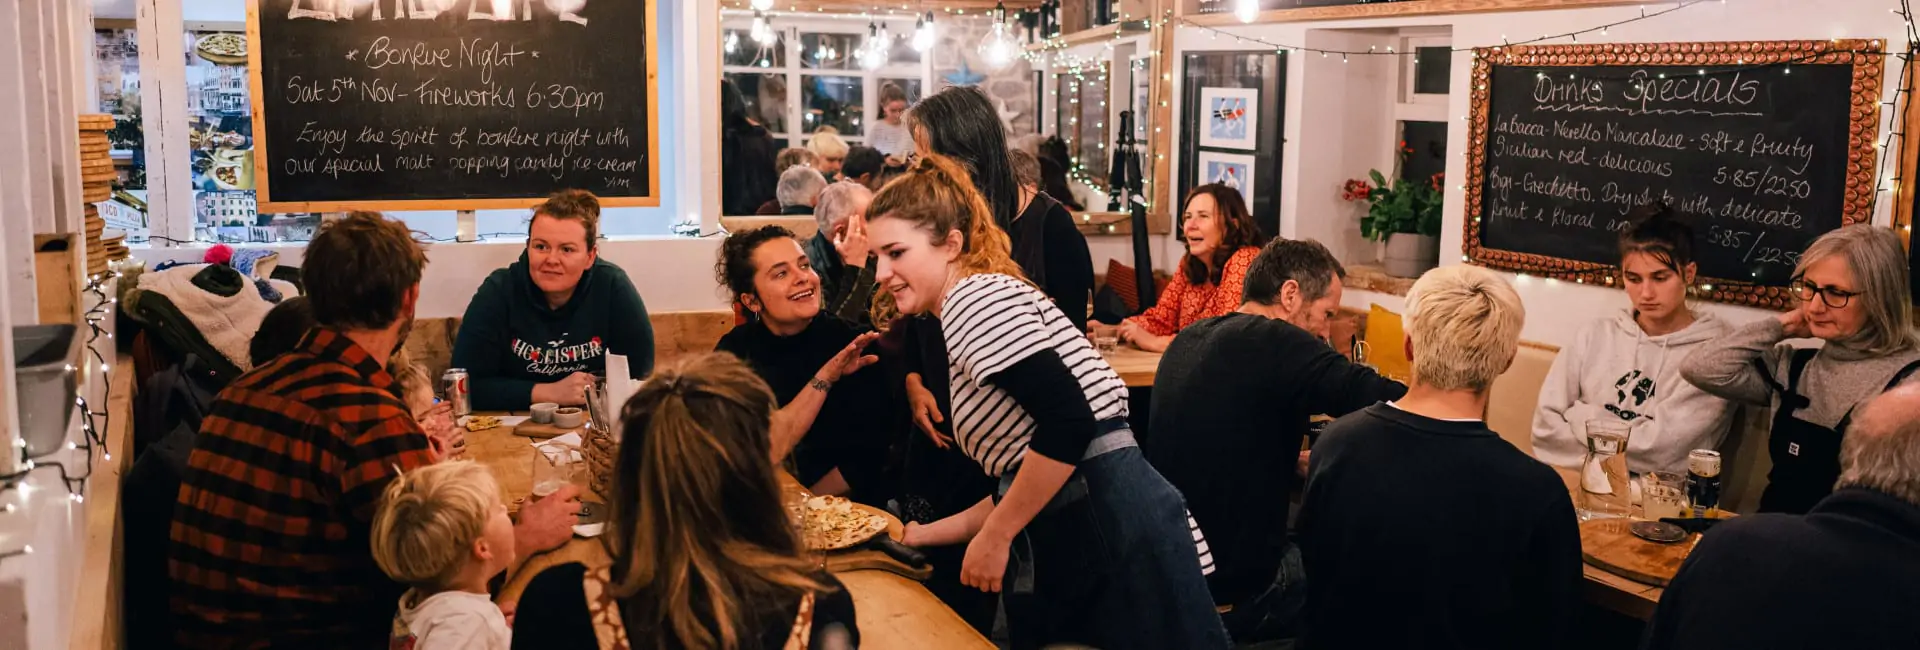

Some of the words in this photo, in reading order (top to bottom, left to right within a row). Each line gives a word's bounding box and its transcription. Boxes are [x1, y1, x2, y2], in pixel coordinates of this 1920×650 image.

[459, 38, 525, 84] Night
[287, 75, 324, 104] Sat
[328, 77, 357, 102] 5th
[414, 78, 515, 108] Fireworks
[1623, 70, 1760, 112] Specials
[296, 120, 347, 156] Enjoy
[355, 125, 384, 144] the
[390, 126, 439, 149] spirit
[450, 126, 469, 149] of
[477, 126, 540, 147] bonfire
[545, 127, 591, 157] night
[596, 127, 629, 148] with
[1494, 136, 1553, 160] Sicilian
[1558, 146, 1591, 165] red
[1553, 119, 1601, 142] Nerello
[1700, 130, 1732, 155] Soft
[1750, 133, 1814, 175] fruity
[284, 157, 317, 175] our
[322, 153, 384, 180] special
[395, 154, 434, 169] malt
[450, 156, 509, 178] popping
[515, 153, 565, 182] candy
[1491, 198, 1529, 222] fruit
[1552, 207, 1597, 229] floral
[1601, 182, 1633, 215] Dry
[1681, 193, 1714, 218] with
[1720, 198, 1803, 229] delicate
[513, 339, 602, 364] HOLLISTER
[526, 362, 588, 376] California
